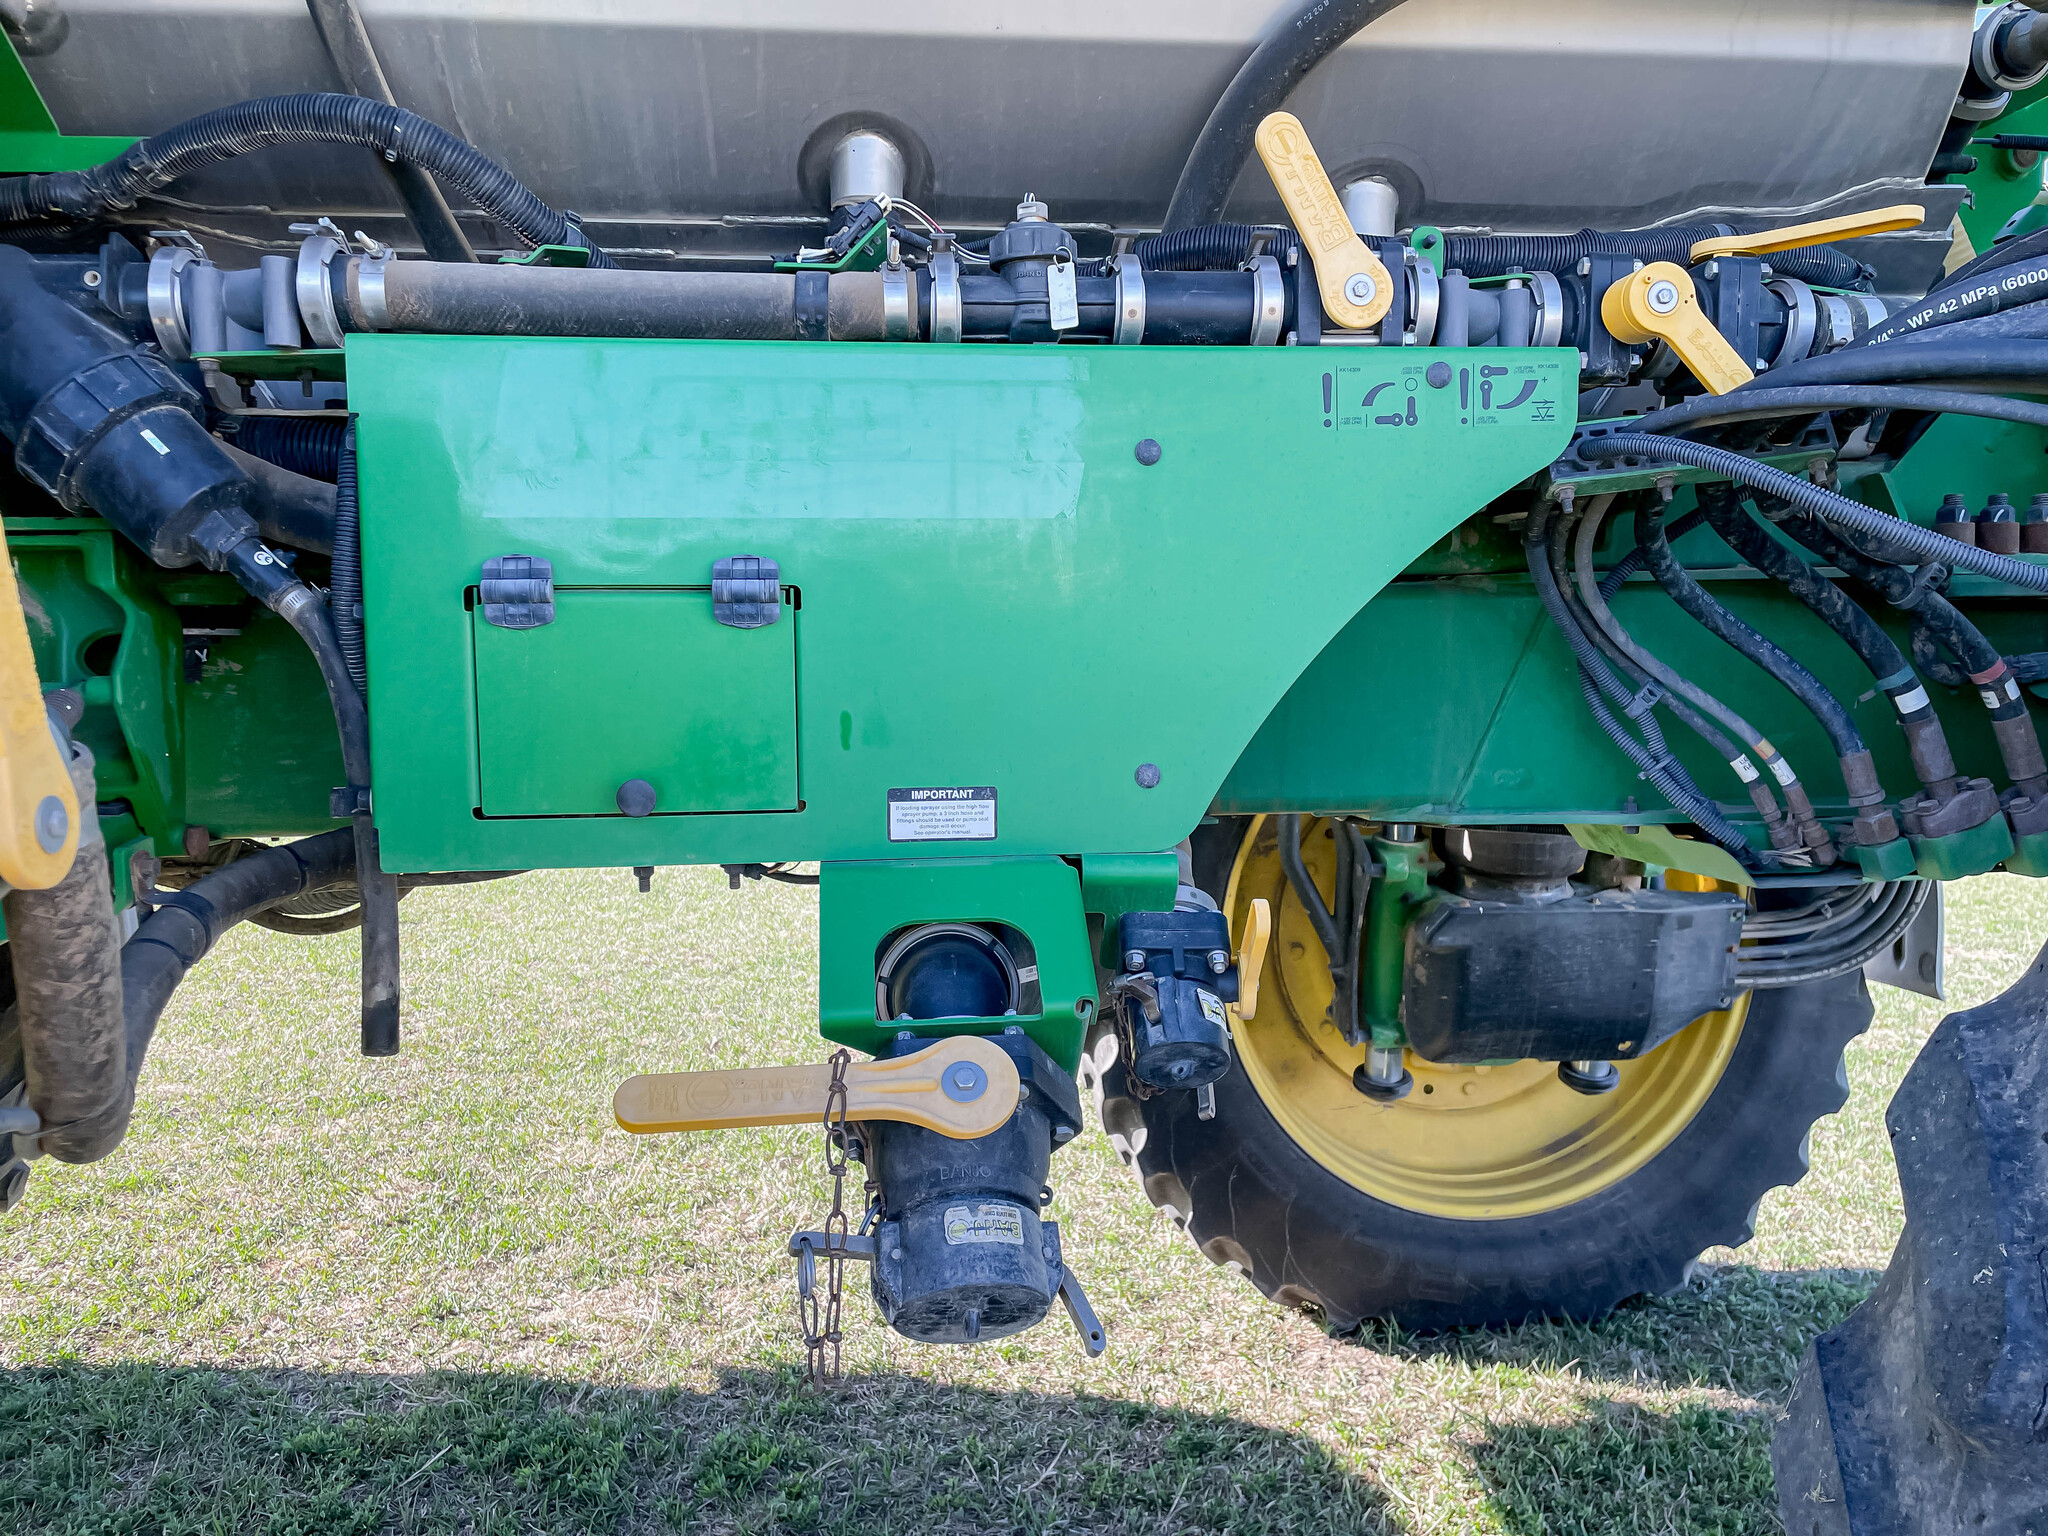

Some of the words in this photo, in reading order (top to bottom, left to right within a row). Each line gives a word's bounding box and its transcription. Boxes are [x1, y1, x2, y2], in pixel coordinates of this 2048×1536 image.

[1907, 309, 1935, 331] WP
[1938, 298, 1959, 314] 42
[1960, 285, 1999, 306] MPa
[2001, 267, 2048, 292] (6000
[1773, 648, 1790, 663] MADE
[1792, 662, 1801, 671] IN
[911, 789, 974, 800] IMPORTANT
[940, 1164, 991, 1180] BANJO
